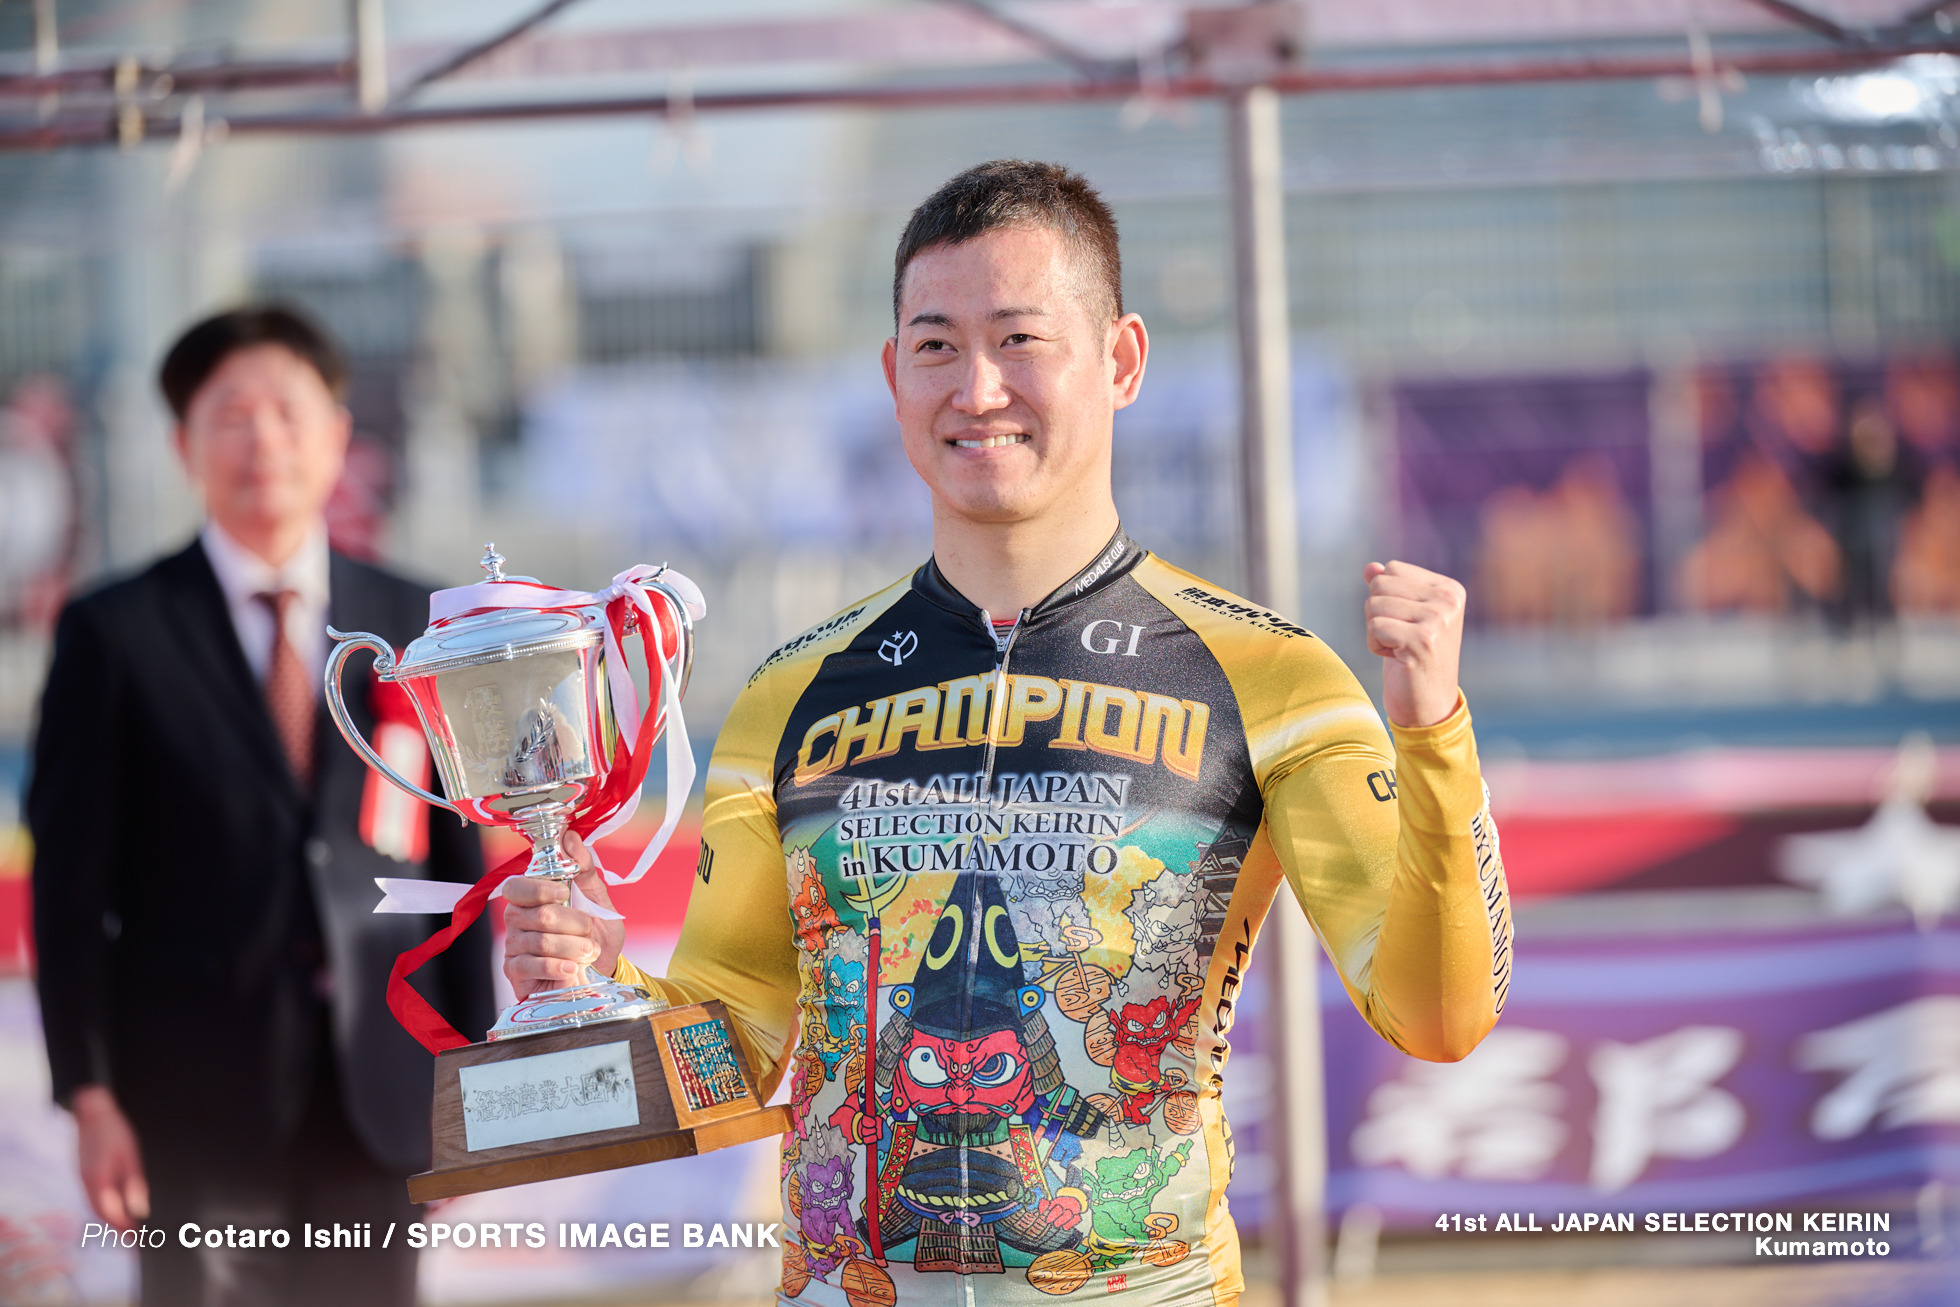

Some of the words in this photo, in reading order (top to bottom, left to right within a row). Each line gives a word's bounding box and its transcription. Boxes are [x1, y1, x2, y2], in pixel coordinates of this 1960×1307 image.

[1074, 557, 1113, 596] MEDALIST
[1110, 540, 1126, 560] CLUB
[1173, 592, 1243, 621] KUMAMOTO
[1249, 620, 1294, 639] KEIRIN
[793, 671, 1210, 788] CHAMPION
[841, 781, 914, 811] 41st
[920, 776, 991, 805] ALL
[998, 775, 1128, 810] JAPAN
[840, 811, 1006, 841] SELECTION
[1012, 812, 1123, 837] KEIRIN
[843, 856, 868, 878] in
[871, 842, 1119, 874] KUMAMOTO
[474, 1069, 626, 1123] 経済産業大臣杯
